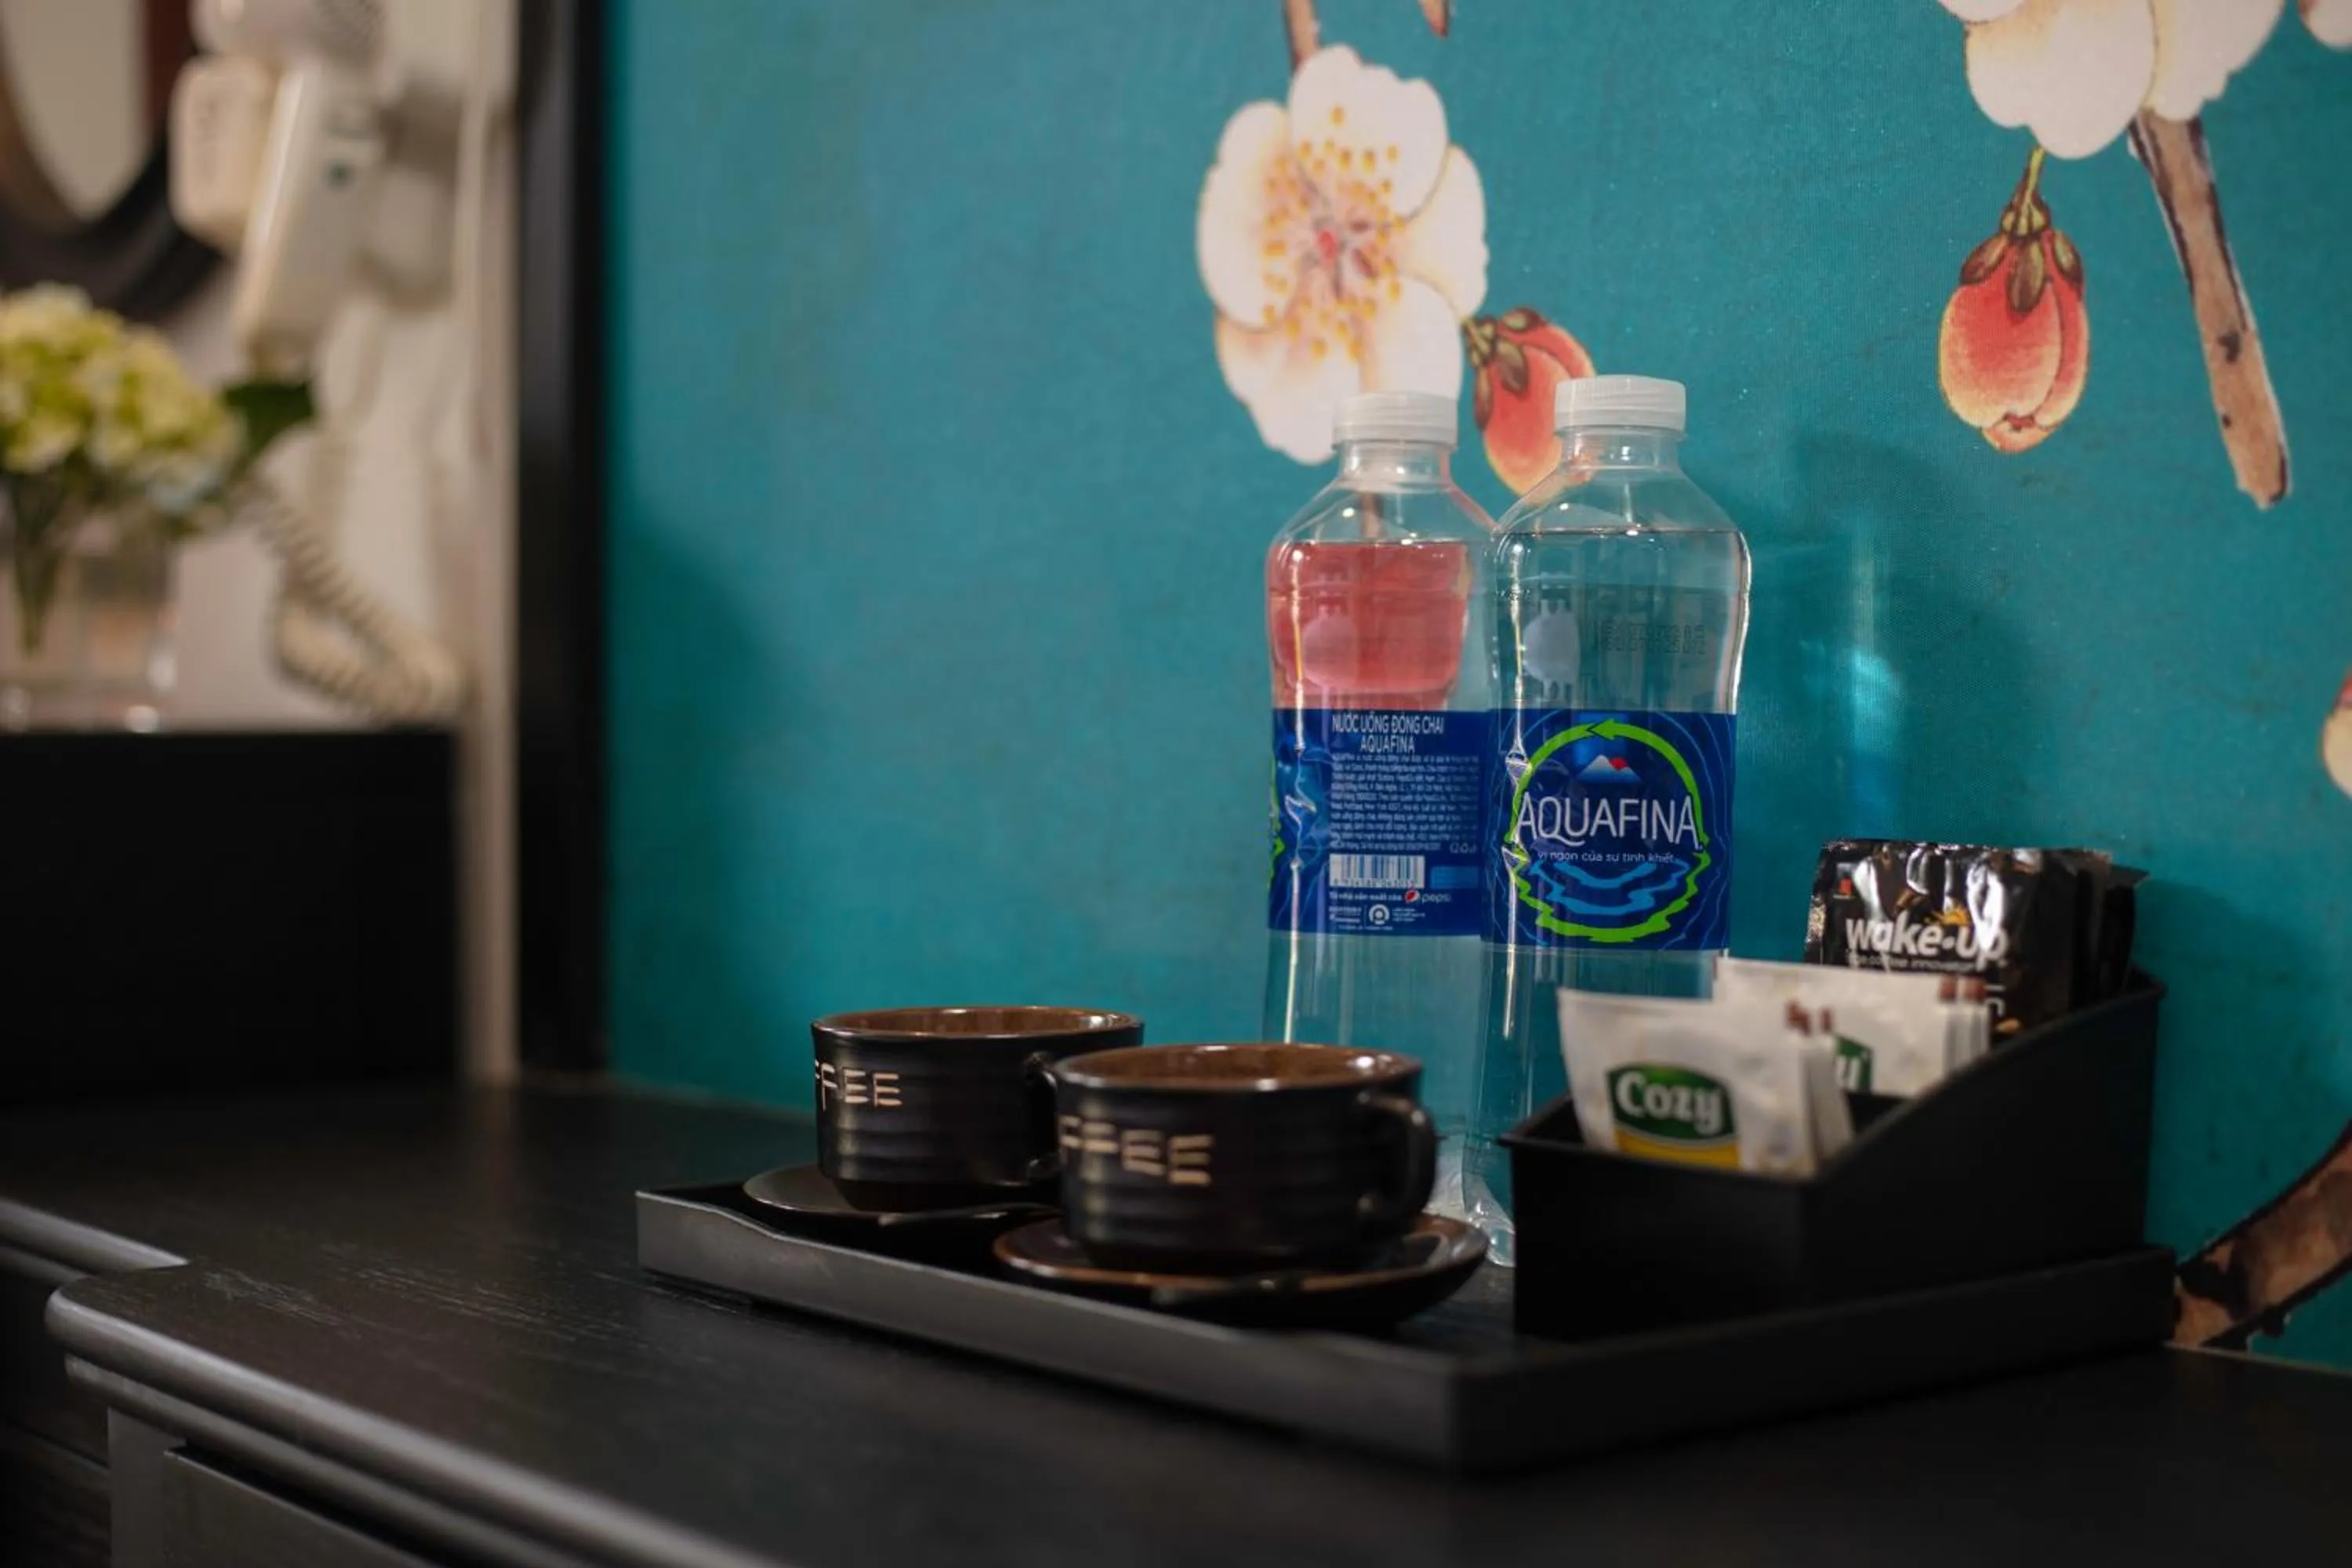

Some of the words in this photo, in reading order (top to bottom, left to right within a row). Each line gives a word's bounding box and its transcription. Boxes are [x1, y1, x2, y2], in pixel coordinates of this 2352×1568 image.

[1422, 715, 1444, 735] CHAI
[1360, 735, 1415, 753] AQUAFINA
[1516, 791, 1700, 849] AQUAFINA
[1549, 851, 1578, 862] ngon
[1615, 1070, 1725, 1136] Cozy
